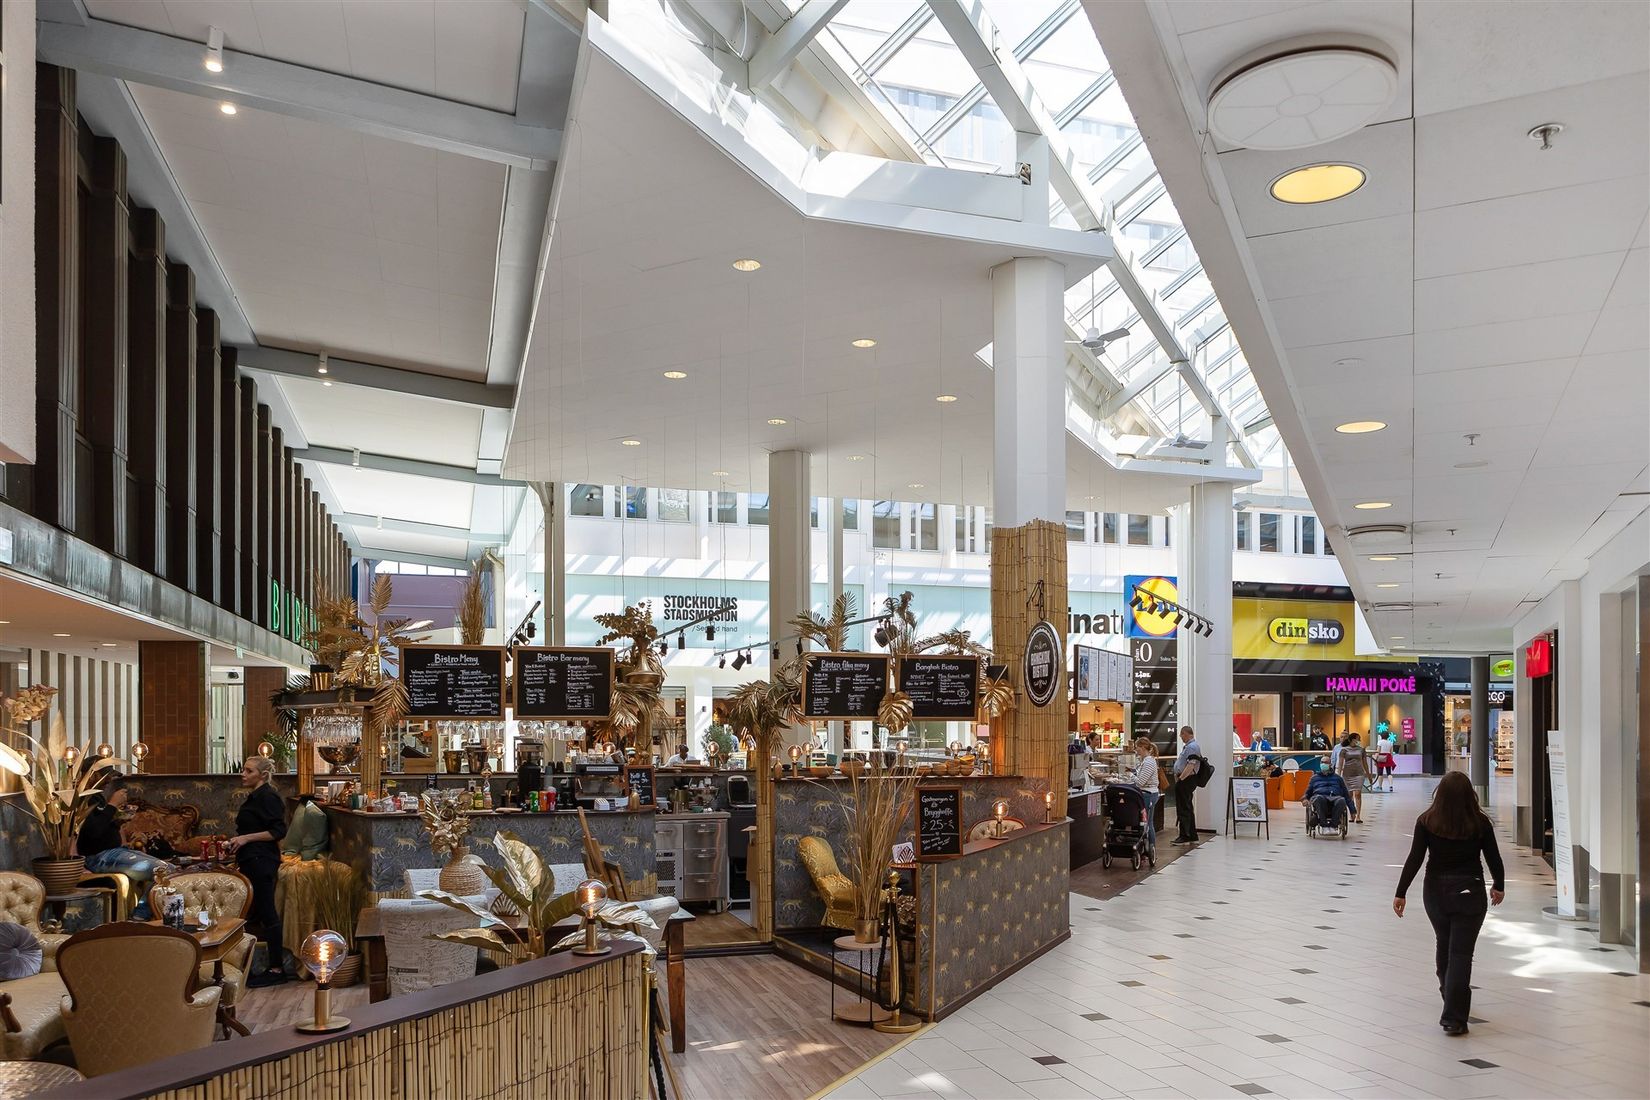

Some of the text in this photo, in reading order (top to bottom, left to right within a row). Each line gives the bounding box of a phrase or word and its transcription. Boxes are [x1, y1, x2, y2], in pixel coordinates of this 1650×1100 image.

[663, 595, 738, 610] STOCKHOLMS
[1276, 622, 1340, 640] dinsko
[434, 653, 459, 664] Bistro
[537, 652, 559, 662] Bistro
[821, 660, 841, 669] Bistro
[915, 663, 940, 673] Bangkok
[1326, 677, 1377, 692] HAWAII
[1488, 691, 1506, 702] CO
